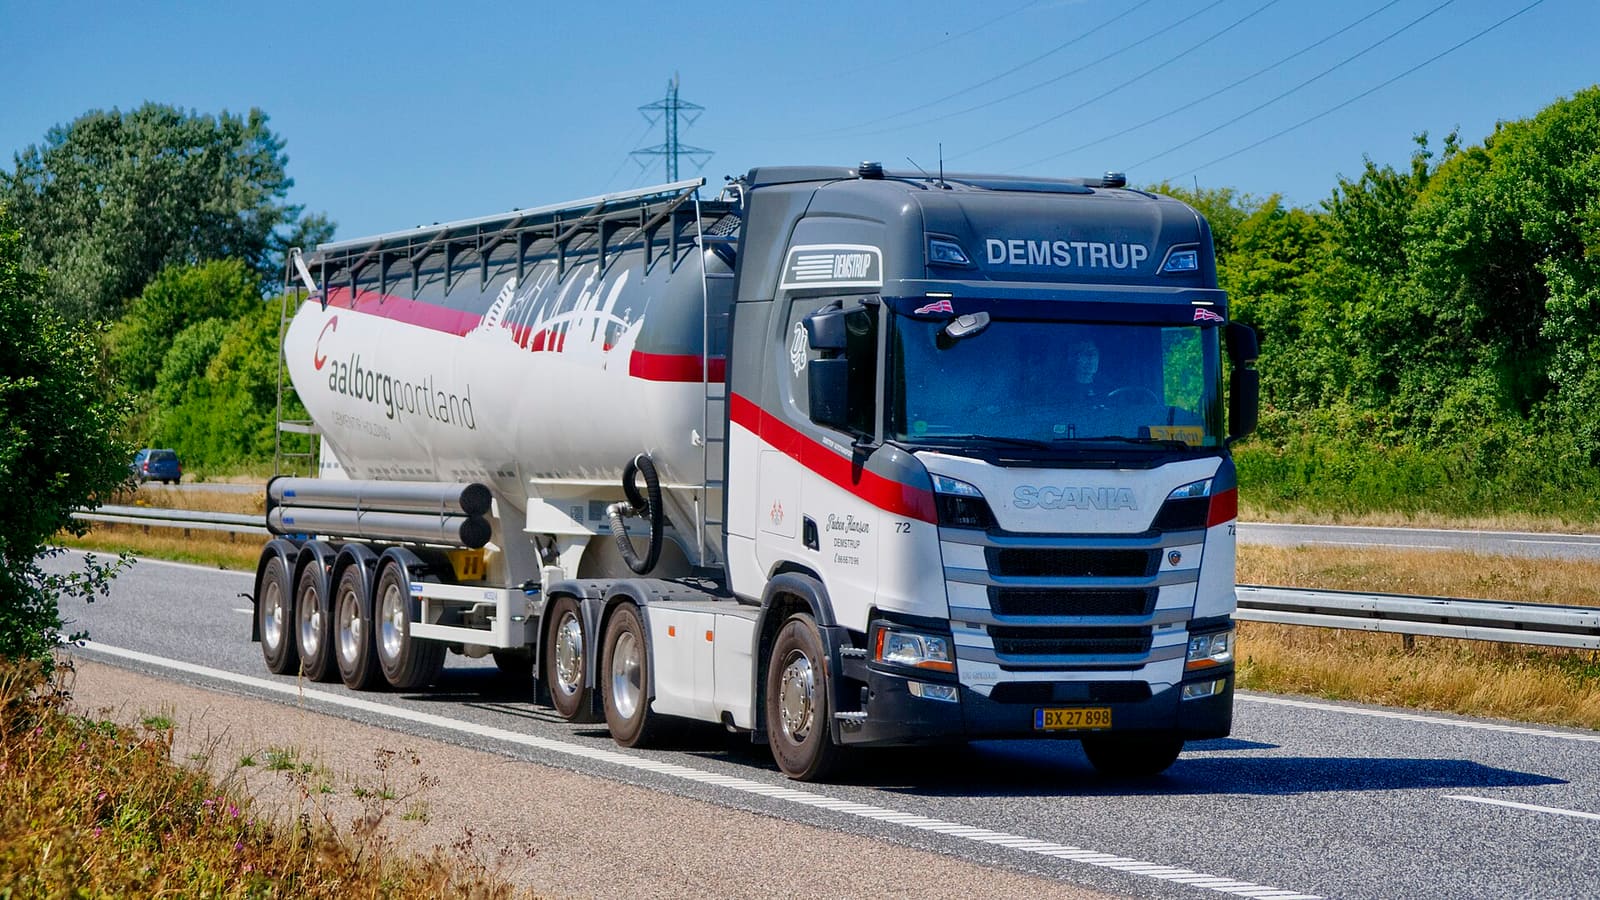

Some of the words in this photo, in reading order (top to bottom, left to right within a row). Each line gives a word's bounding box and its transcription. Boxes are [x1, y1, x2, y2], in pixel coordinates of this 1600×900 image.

[833, 253, 872, 279] DEMSTRUP
[986, 239, 1148, 269] DEMSTRUP
[328, 352, 477, 431] aalborgportland
[1013, 485, 1139, 511] SCANIA
[894, 522, 911, 534] 72
[833, 537, 861, 549] DEMSTRUP
[1045, 711, 1063, 726] BX
[1066, 711, 1082, 726] 27
[1085, 710, 1110, 725] 898
